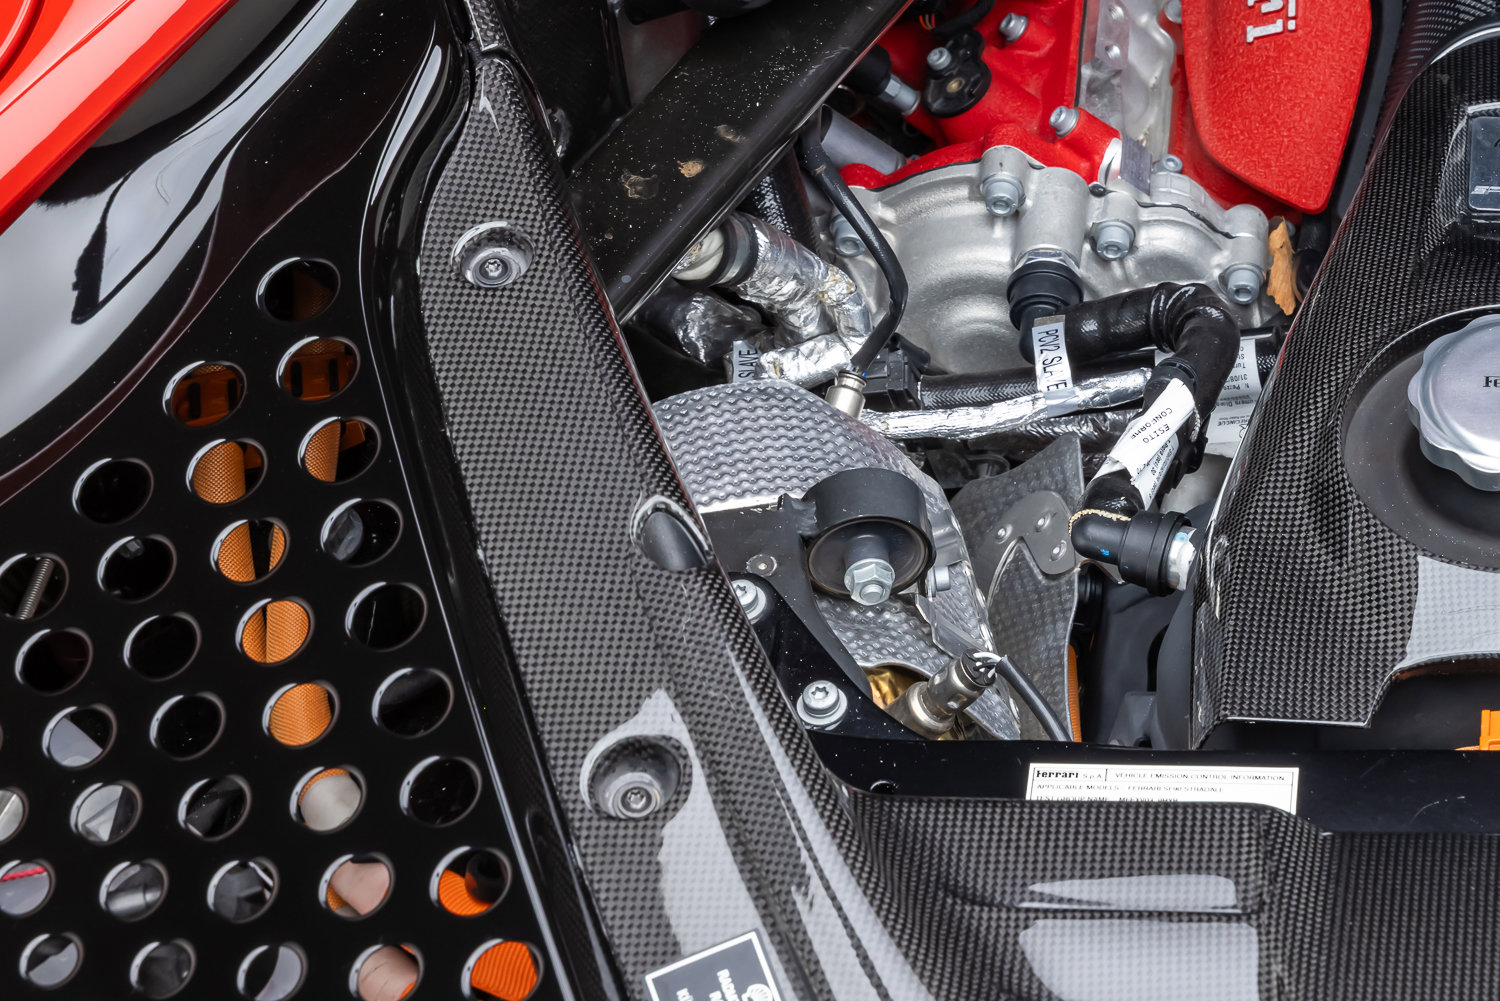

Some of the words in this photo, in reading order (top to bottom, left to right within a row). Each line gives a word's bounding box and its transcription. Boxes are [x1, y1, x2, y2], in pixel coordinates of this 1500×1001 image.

[1037, 328, 1060, 358] PCV2
[738, 349, 759, 378] SLAVE
[1142, 423, 1170, 443] ESITO
[1036, 770, 1079, 779] Ferrari
[717, 968, 743, 1001] RADIA
